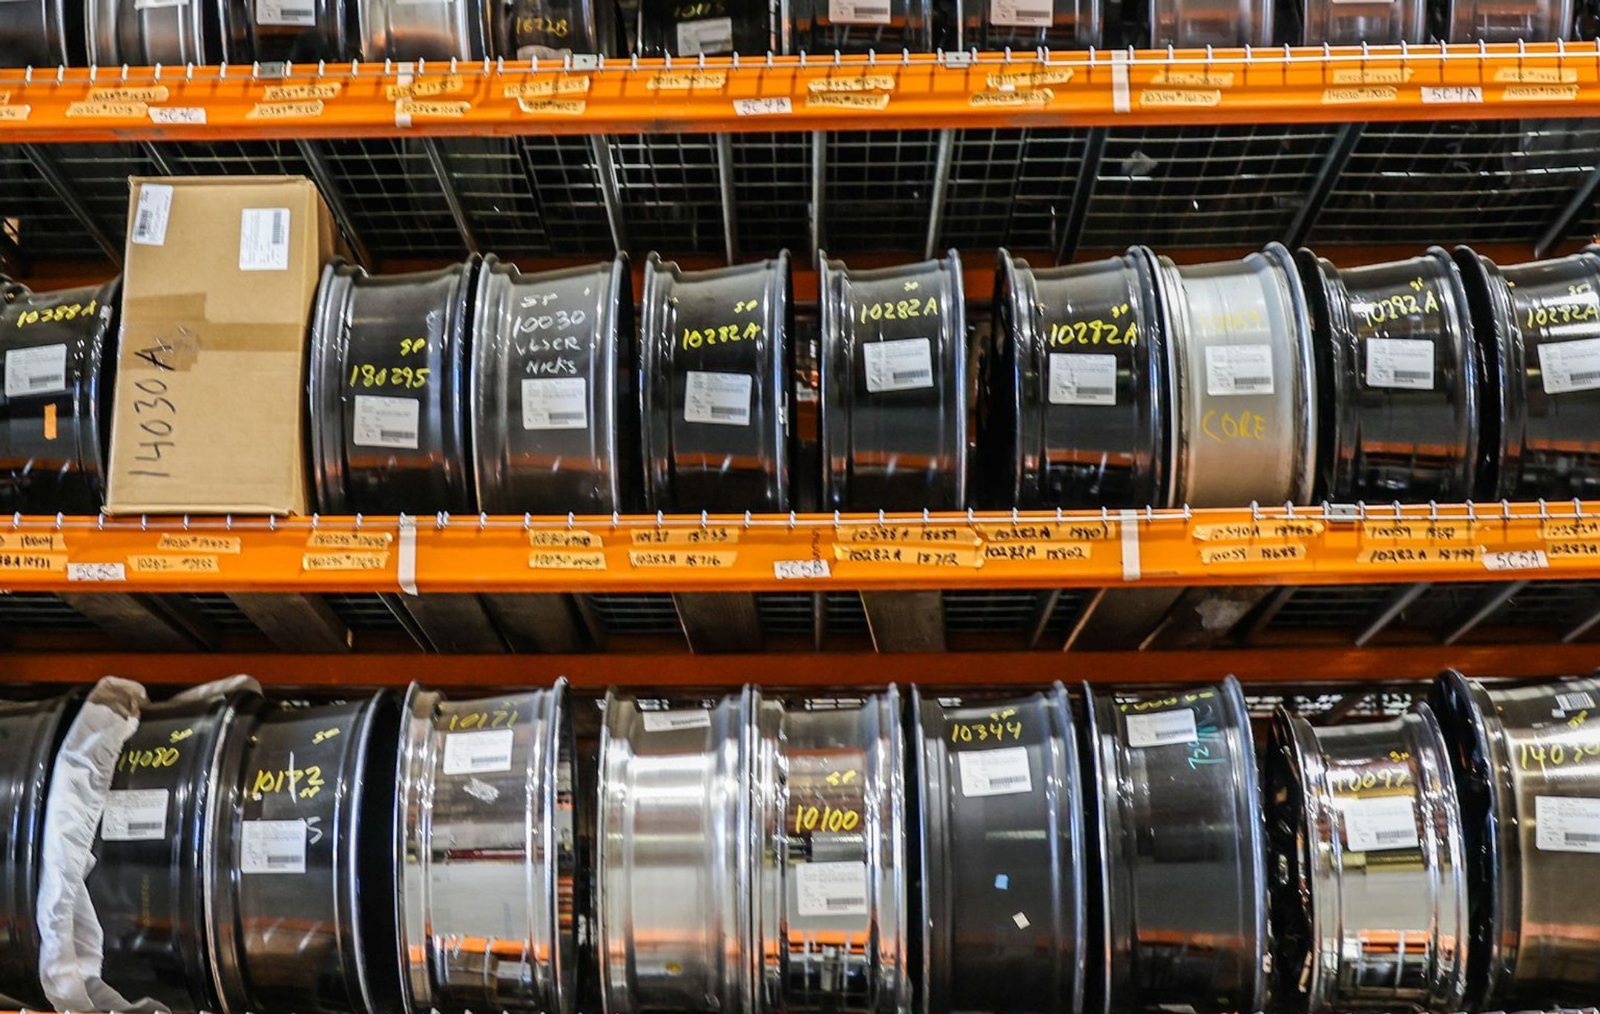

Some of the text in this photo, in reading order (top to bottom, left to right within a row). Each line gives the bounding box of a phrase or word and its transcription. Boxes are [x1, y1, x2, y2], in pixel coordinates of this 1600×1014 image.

[512, 310, 586, 339] 10030
[861, 296, 938, 324] 10282A
[682, 322, 761, 351] 10282A
[951, 722, 1022, 743] 10344
[795, 804, 859, 834] 10100
